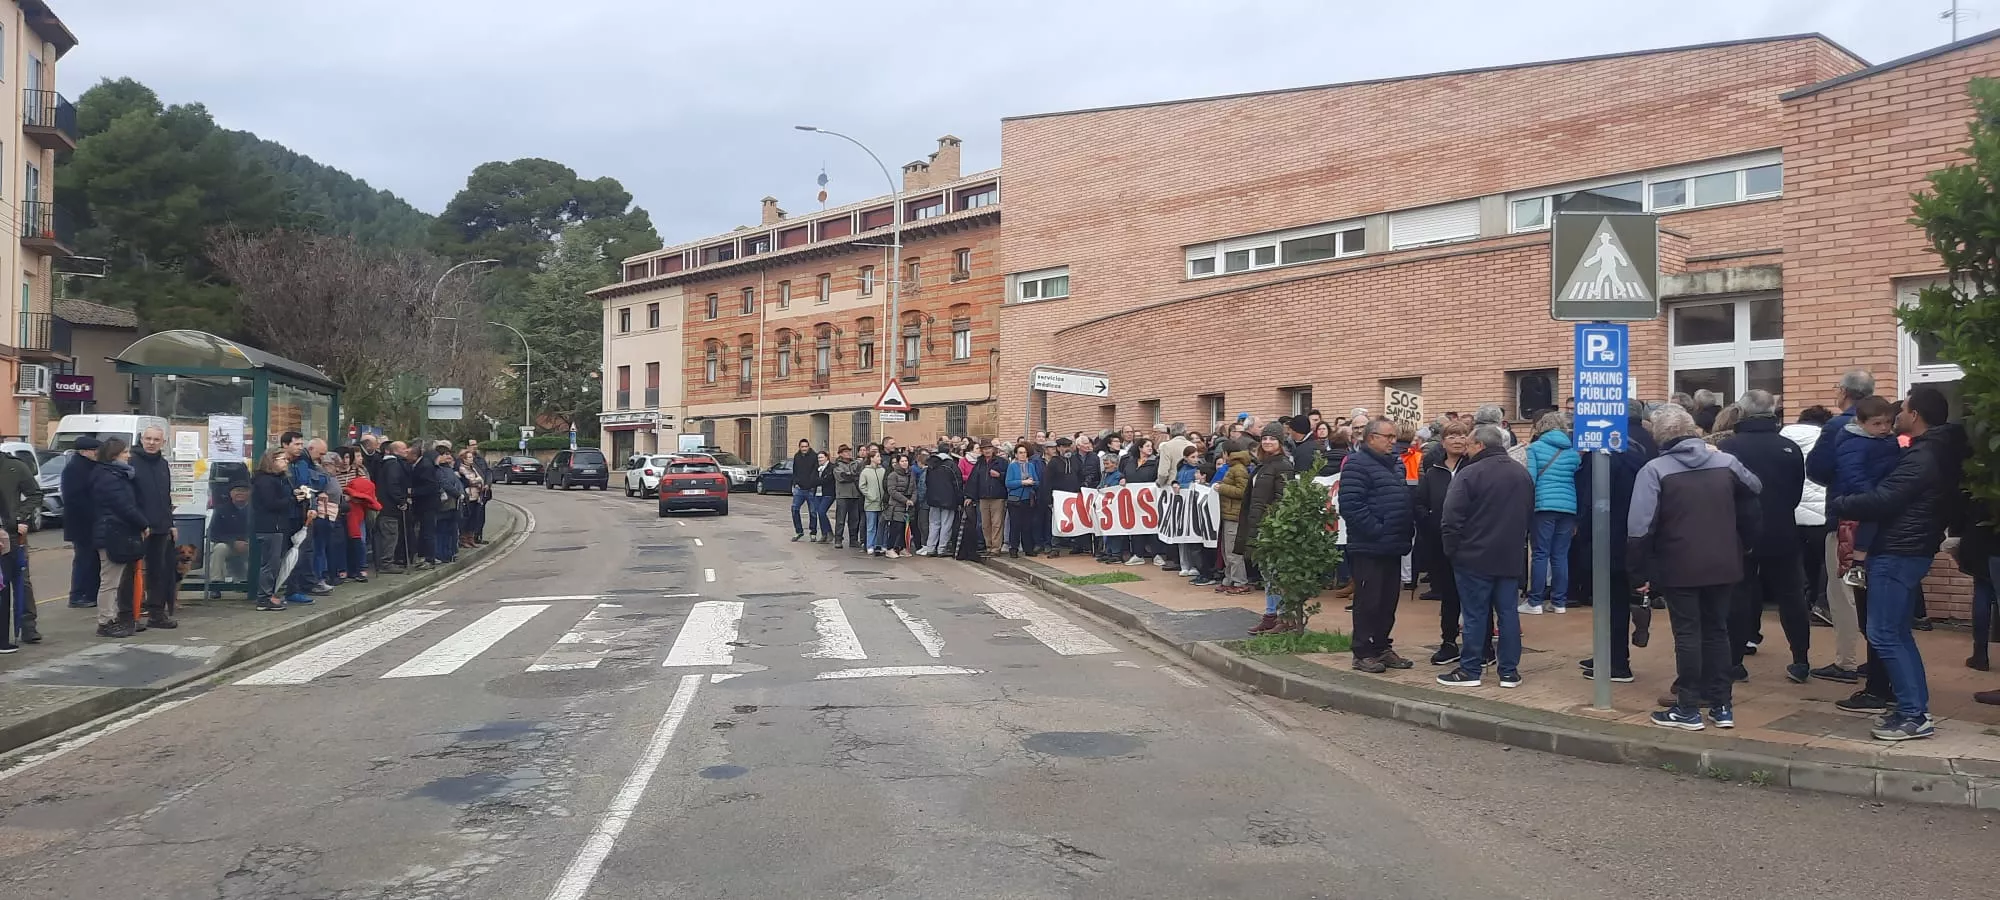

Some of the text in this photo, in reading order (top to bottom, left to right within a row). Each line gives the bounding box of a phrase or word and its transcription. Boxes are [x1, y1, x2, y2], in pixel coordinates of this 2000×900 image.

[1587, 334, 1608, 362] P
[1580, 371, 1623, 385] PARKING
[1580, 384, 1623, 400] PÚBLICO
[1390, 391, 1419, 410] SOS
[1386, 405, 1422, 422] SANIDAD
[1577, 402, 1625, 416] GRATUITO
[1584, 431, 1603, 441] 500
[1101, 488, 1158, 531] SOS
